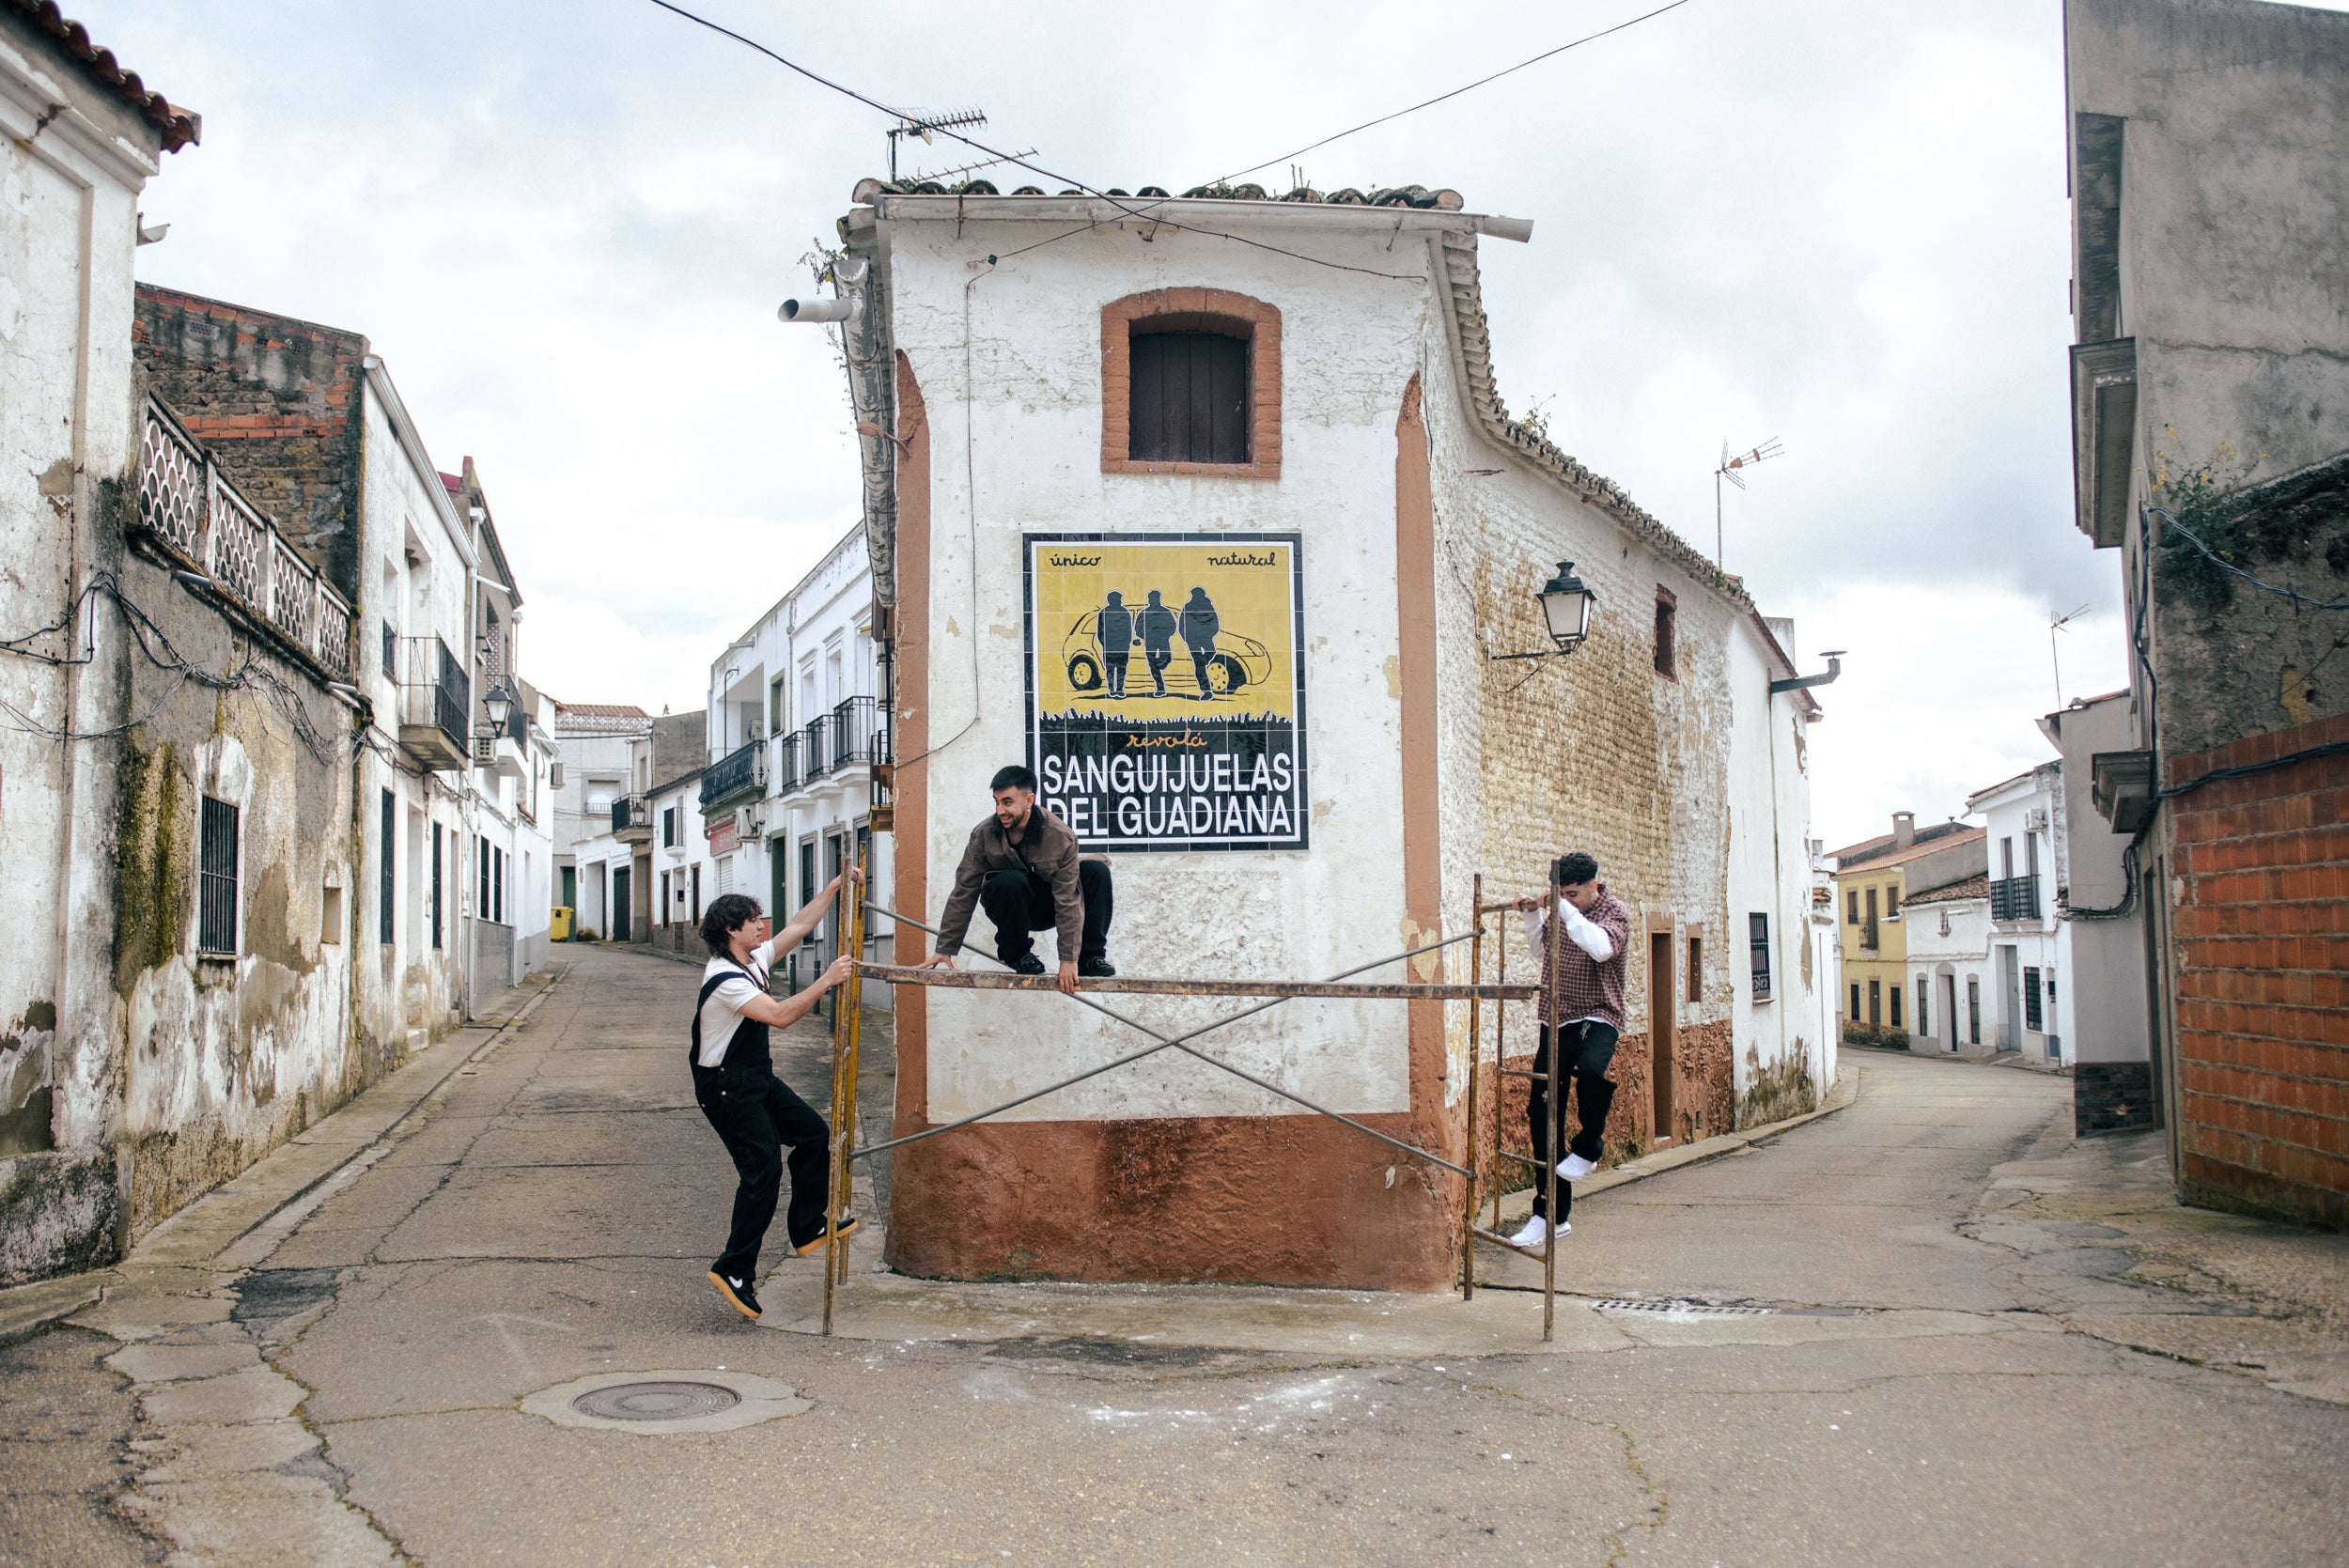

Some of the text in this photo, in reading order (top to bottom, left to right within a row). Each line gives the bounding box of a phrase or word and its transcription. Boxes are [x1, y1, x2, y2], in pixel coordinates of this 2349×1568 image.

[1050, 552, 1101, 567] único
[1207, 551, 1276, 567] natural
[1043, 753, 1292, 795] SANGUIJUELAS
[1047, 795, 1292, 836] DEL GUADIANA
